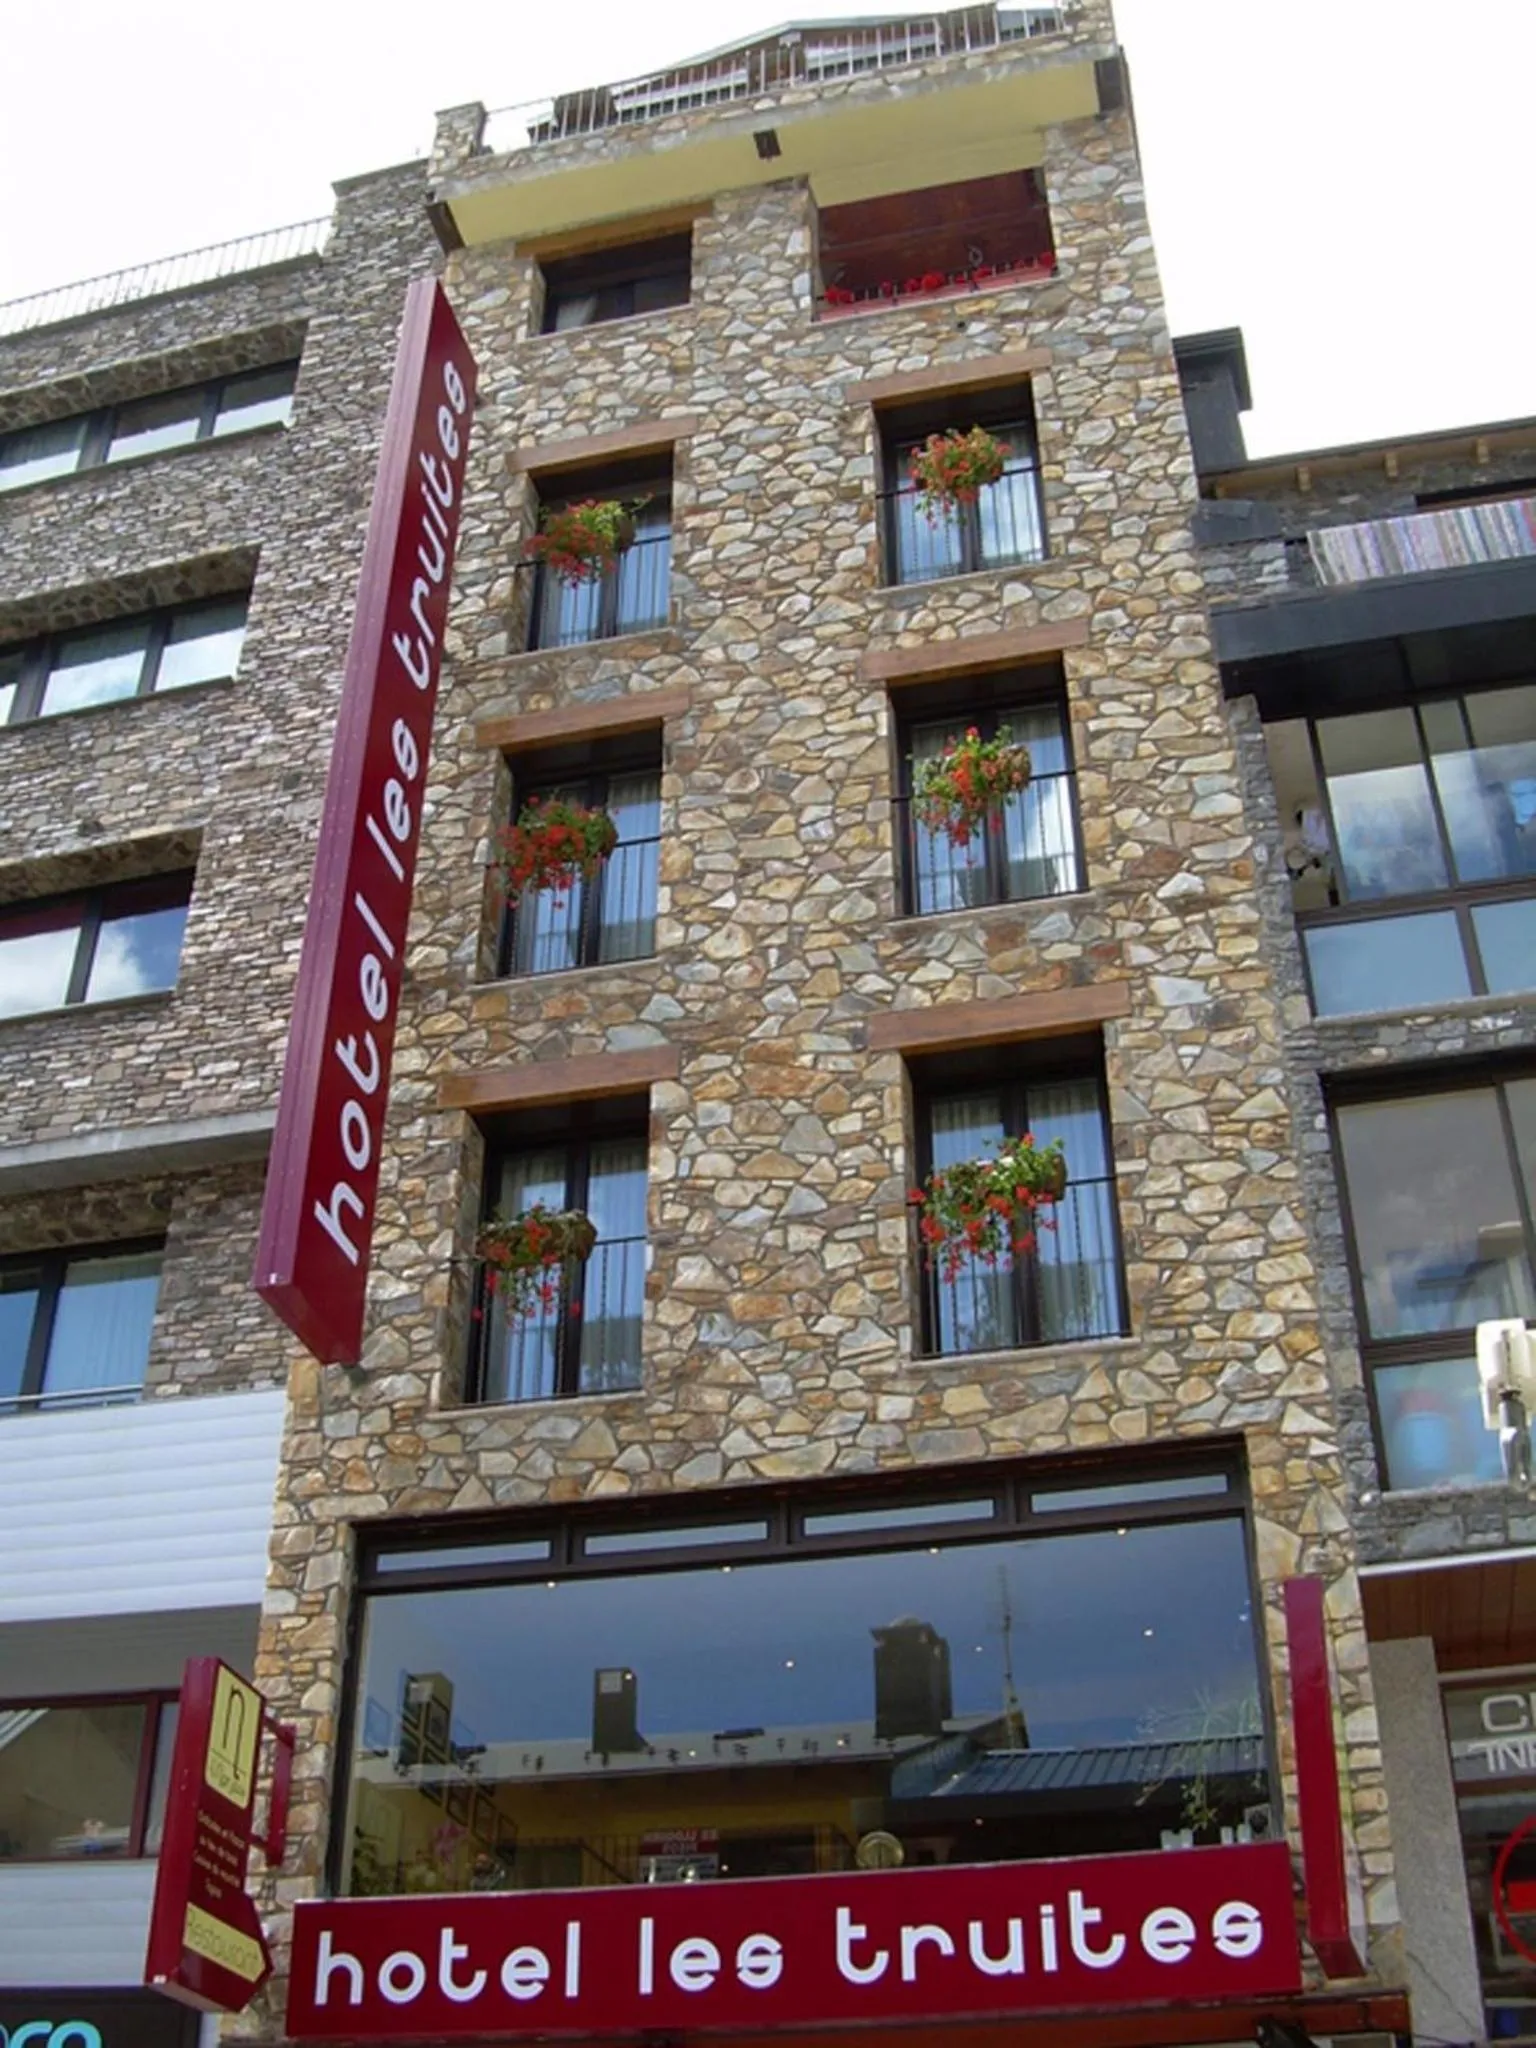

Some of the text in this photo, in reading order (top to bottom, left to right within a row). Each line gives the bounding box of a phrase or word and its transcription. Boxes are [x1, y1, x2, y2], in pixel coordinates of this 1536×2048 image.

[313, 361, 467, 1268] hotel les truites
[316, 1891, 1263, 2004] hotel les truites
